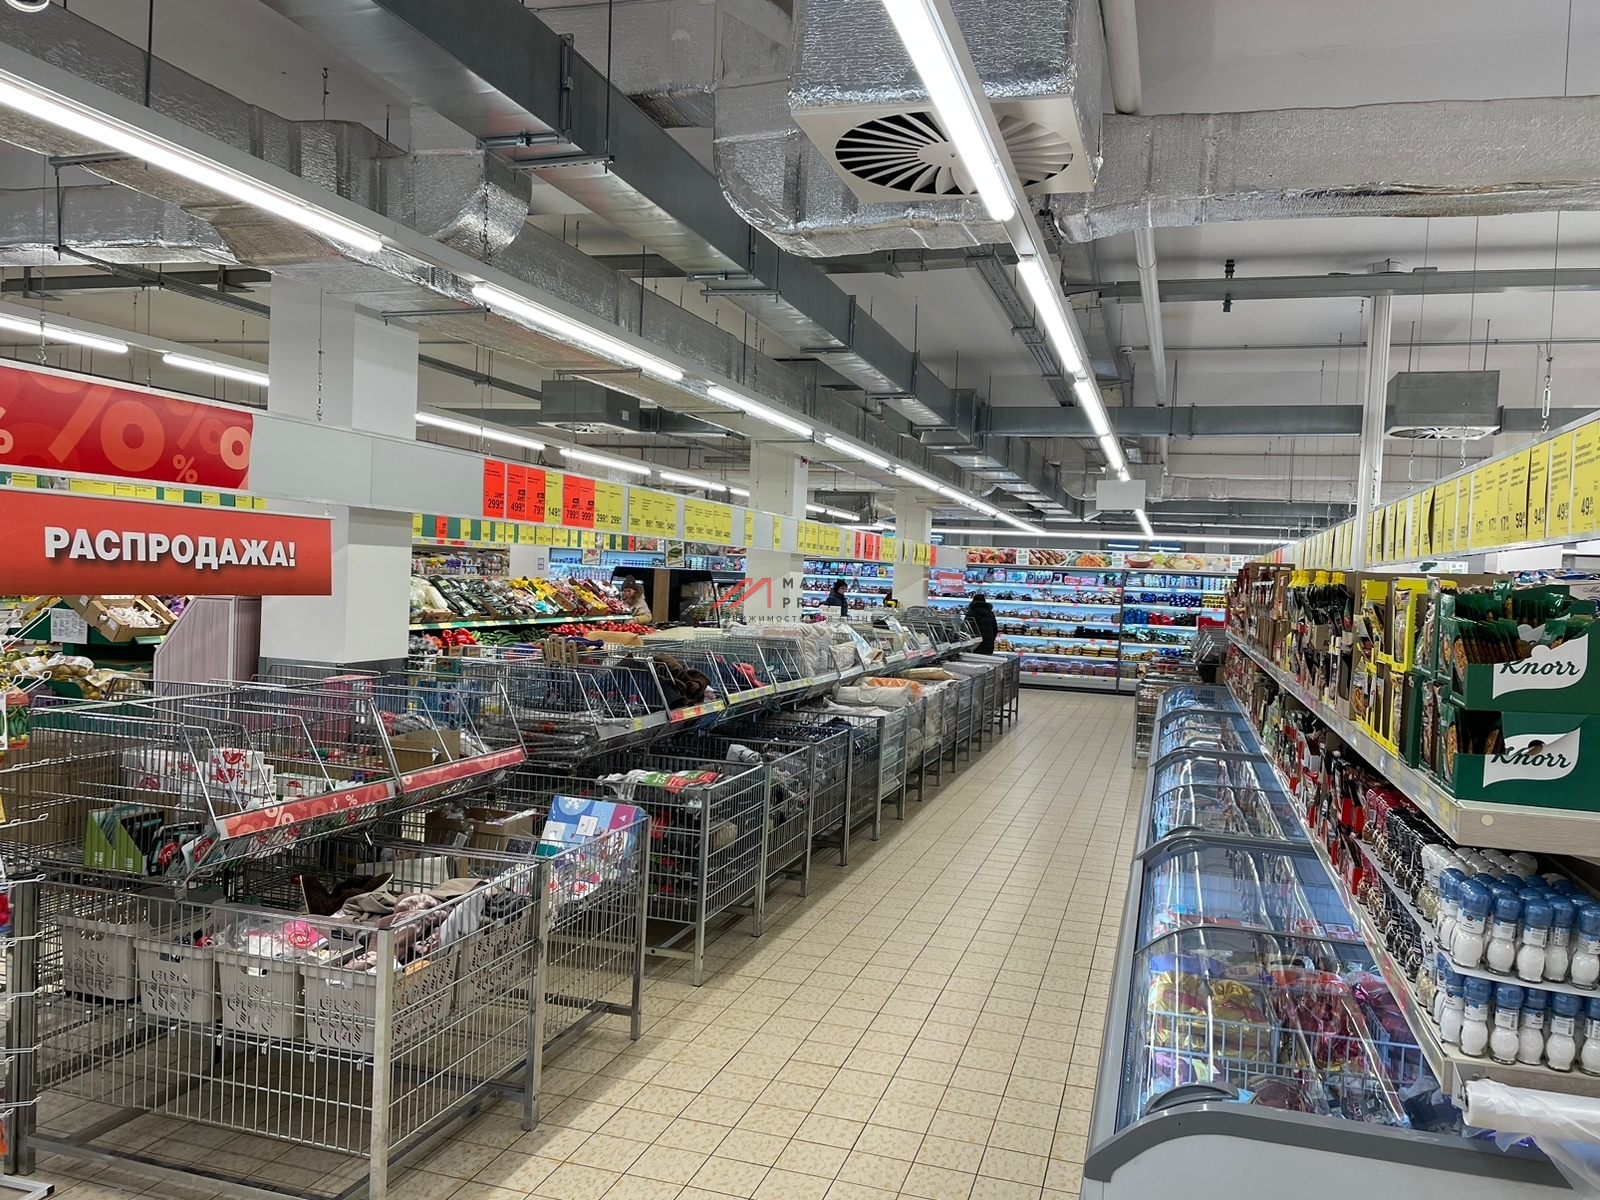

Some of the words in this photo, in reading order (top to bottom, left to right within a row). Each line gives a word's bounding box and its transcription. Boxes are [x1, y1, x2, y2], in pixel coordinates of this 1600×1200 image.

[487, 498, 500, 509] 299
[510, 501, 522, 513] 499
[533, 504, 541, 515] 79
[547, 507, 559, 517] 149
[1556, 503, 1565, 521] 49
[1581, 496, 1590, 516] 49
[44, 526, 296, 569] РАСПРОДАЖА!
[1500, 659, 1581, 677] Knorr
[1491, 746, 1572, 769] Knorr
